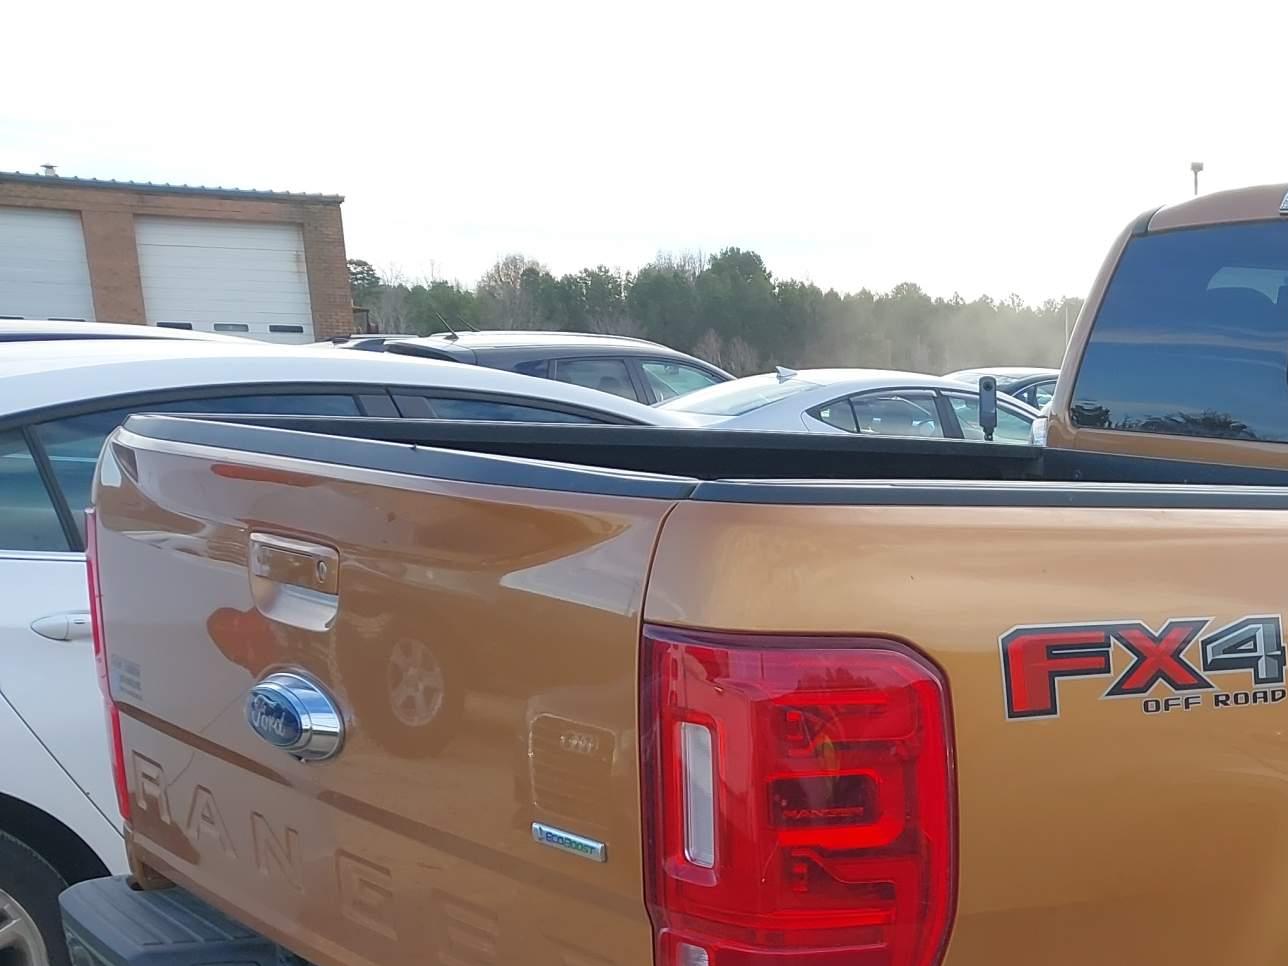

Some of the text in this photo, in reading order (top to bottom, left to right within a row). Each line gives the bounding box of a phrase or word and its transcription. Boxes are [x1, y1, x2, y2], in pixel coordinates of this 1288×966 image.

[999, 614, 1288, 721] FX4
[251, 694, 286, 737] Ford
[1143, 688, 1288, 714] OFF ROAD
